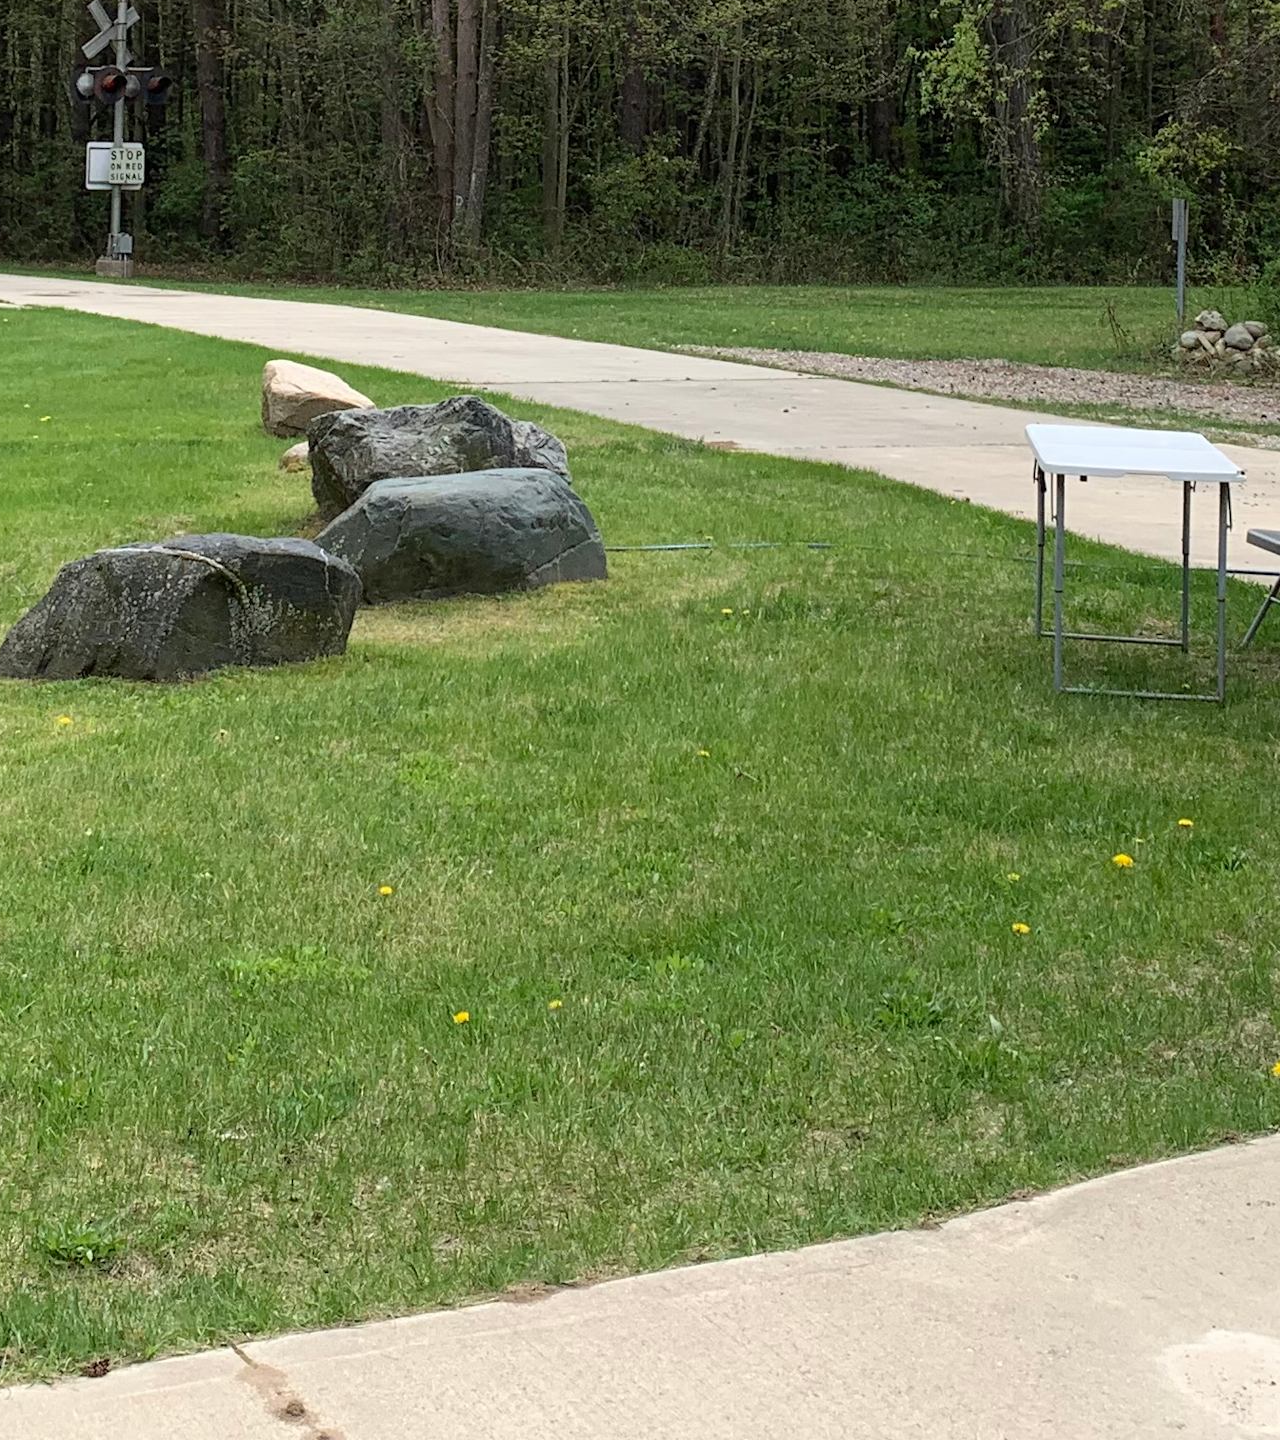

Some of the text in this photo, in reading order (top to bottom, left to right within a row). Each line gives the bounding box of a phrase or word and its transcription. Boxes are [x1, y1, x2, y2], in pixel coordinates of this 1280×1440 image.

[111, 150, 143, 161] STOP
[110, 162, 143, 171] ON RED
[110, 173, 143, 181] SIGNAL
